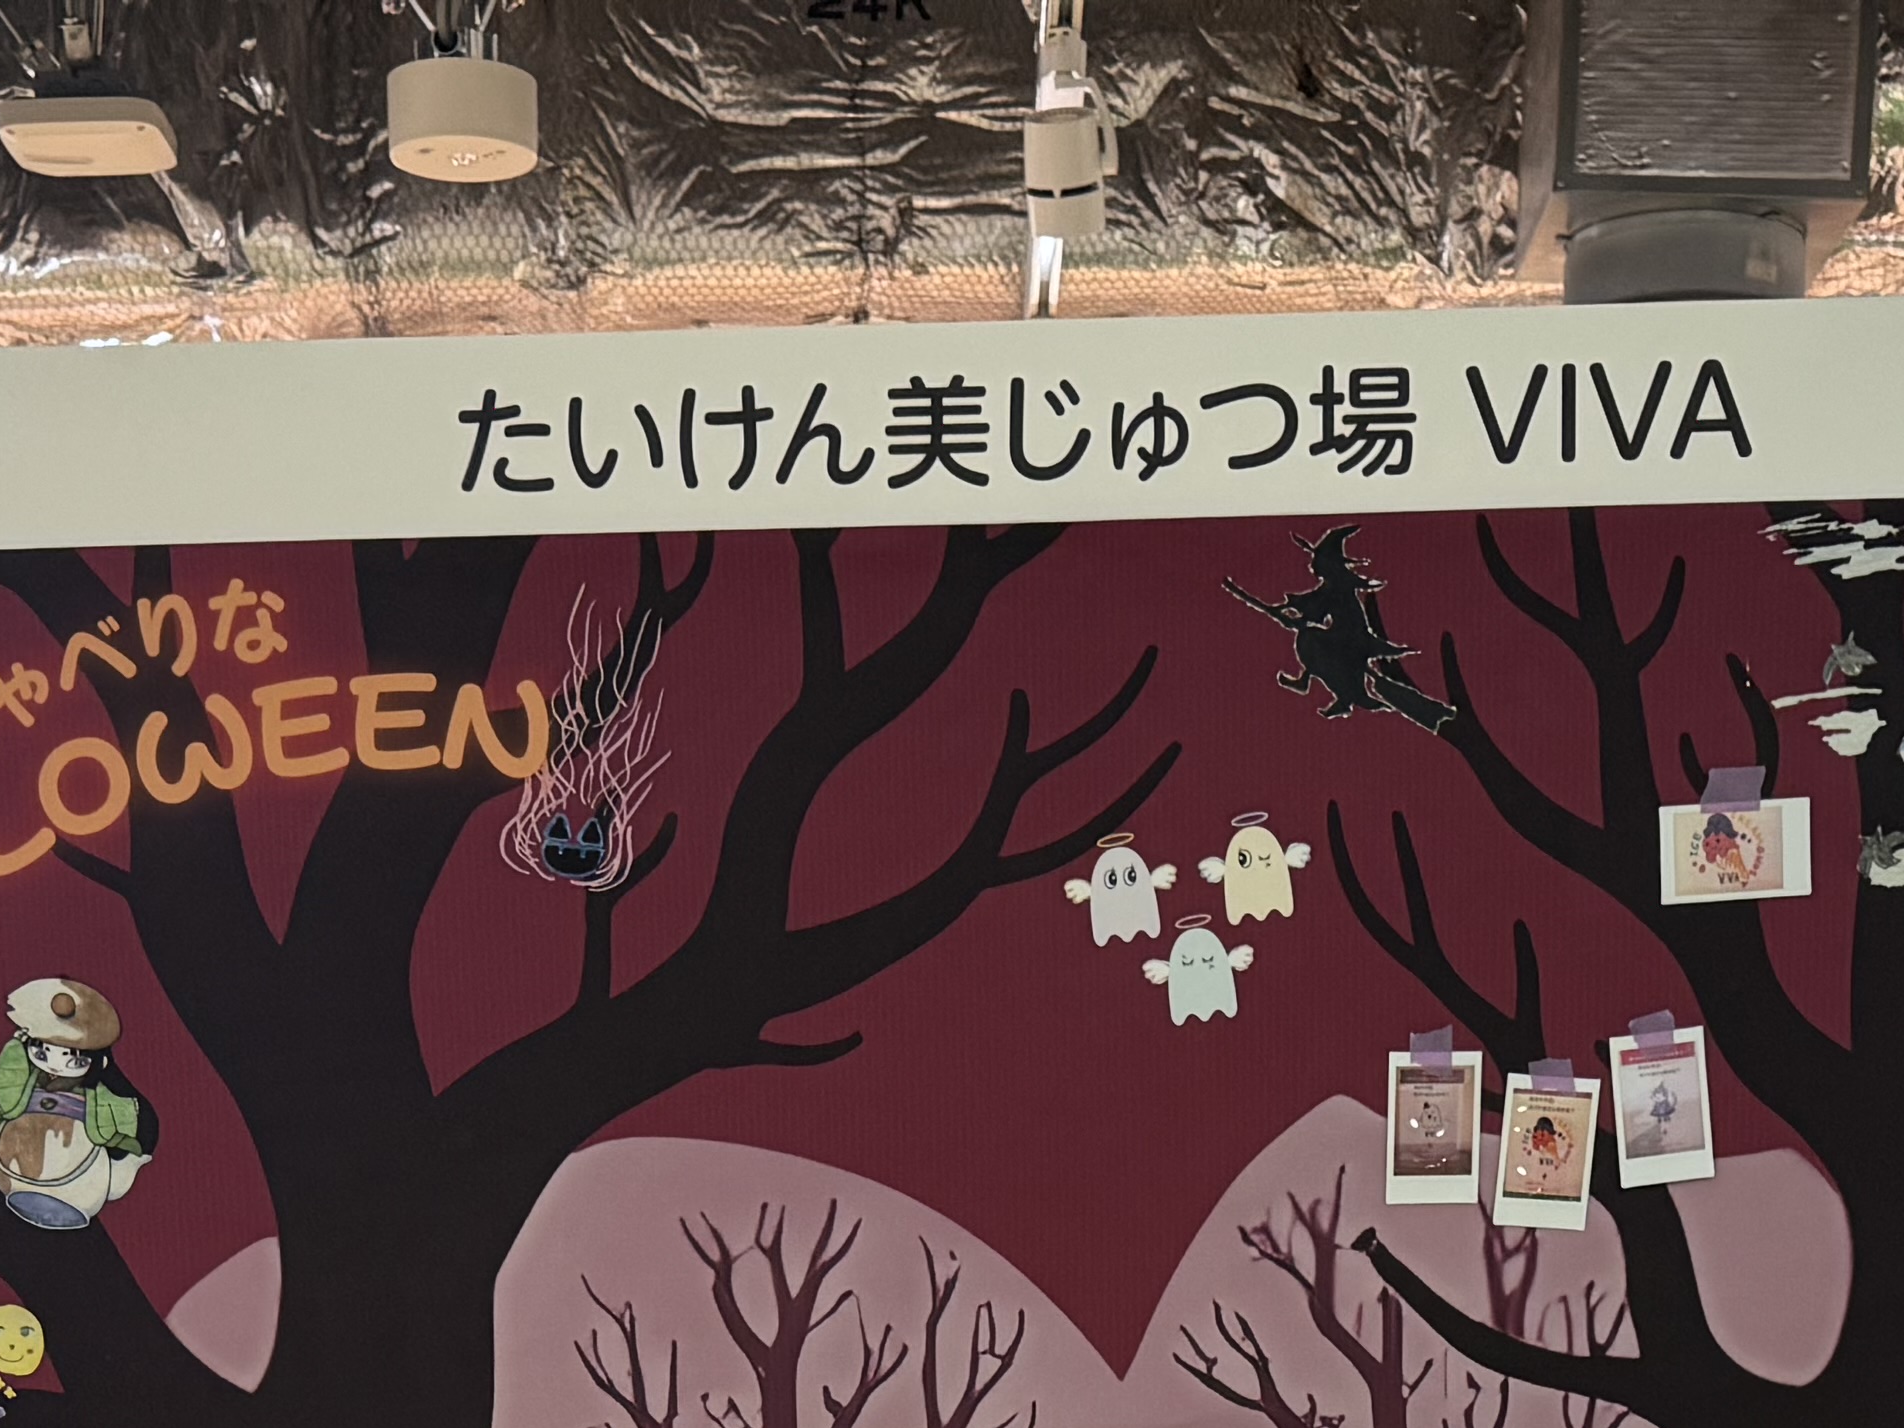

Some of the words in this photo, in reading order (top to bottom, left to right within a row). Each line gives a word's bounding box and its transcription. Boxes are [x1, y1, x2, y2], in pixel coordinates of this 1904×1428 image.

[458, 363, 1414, 493] たいけん美じゅつ場
[1464, 359, 1753, 463] VIVA
